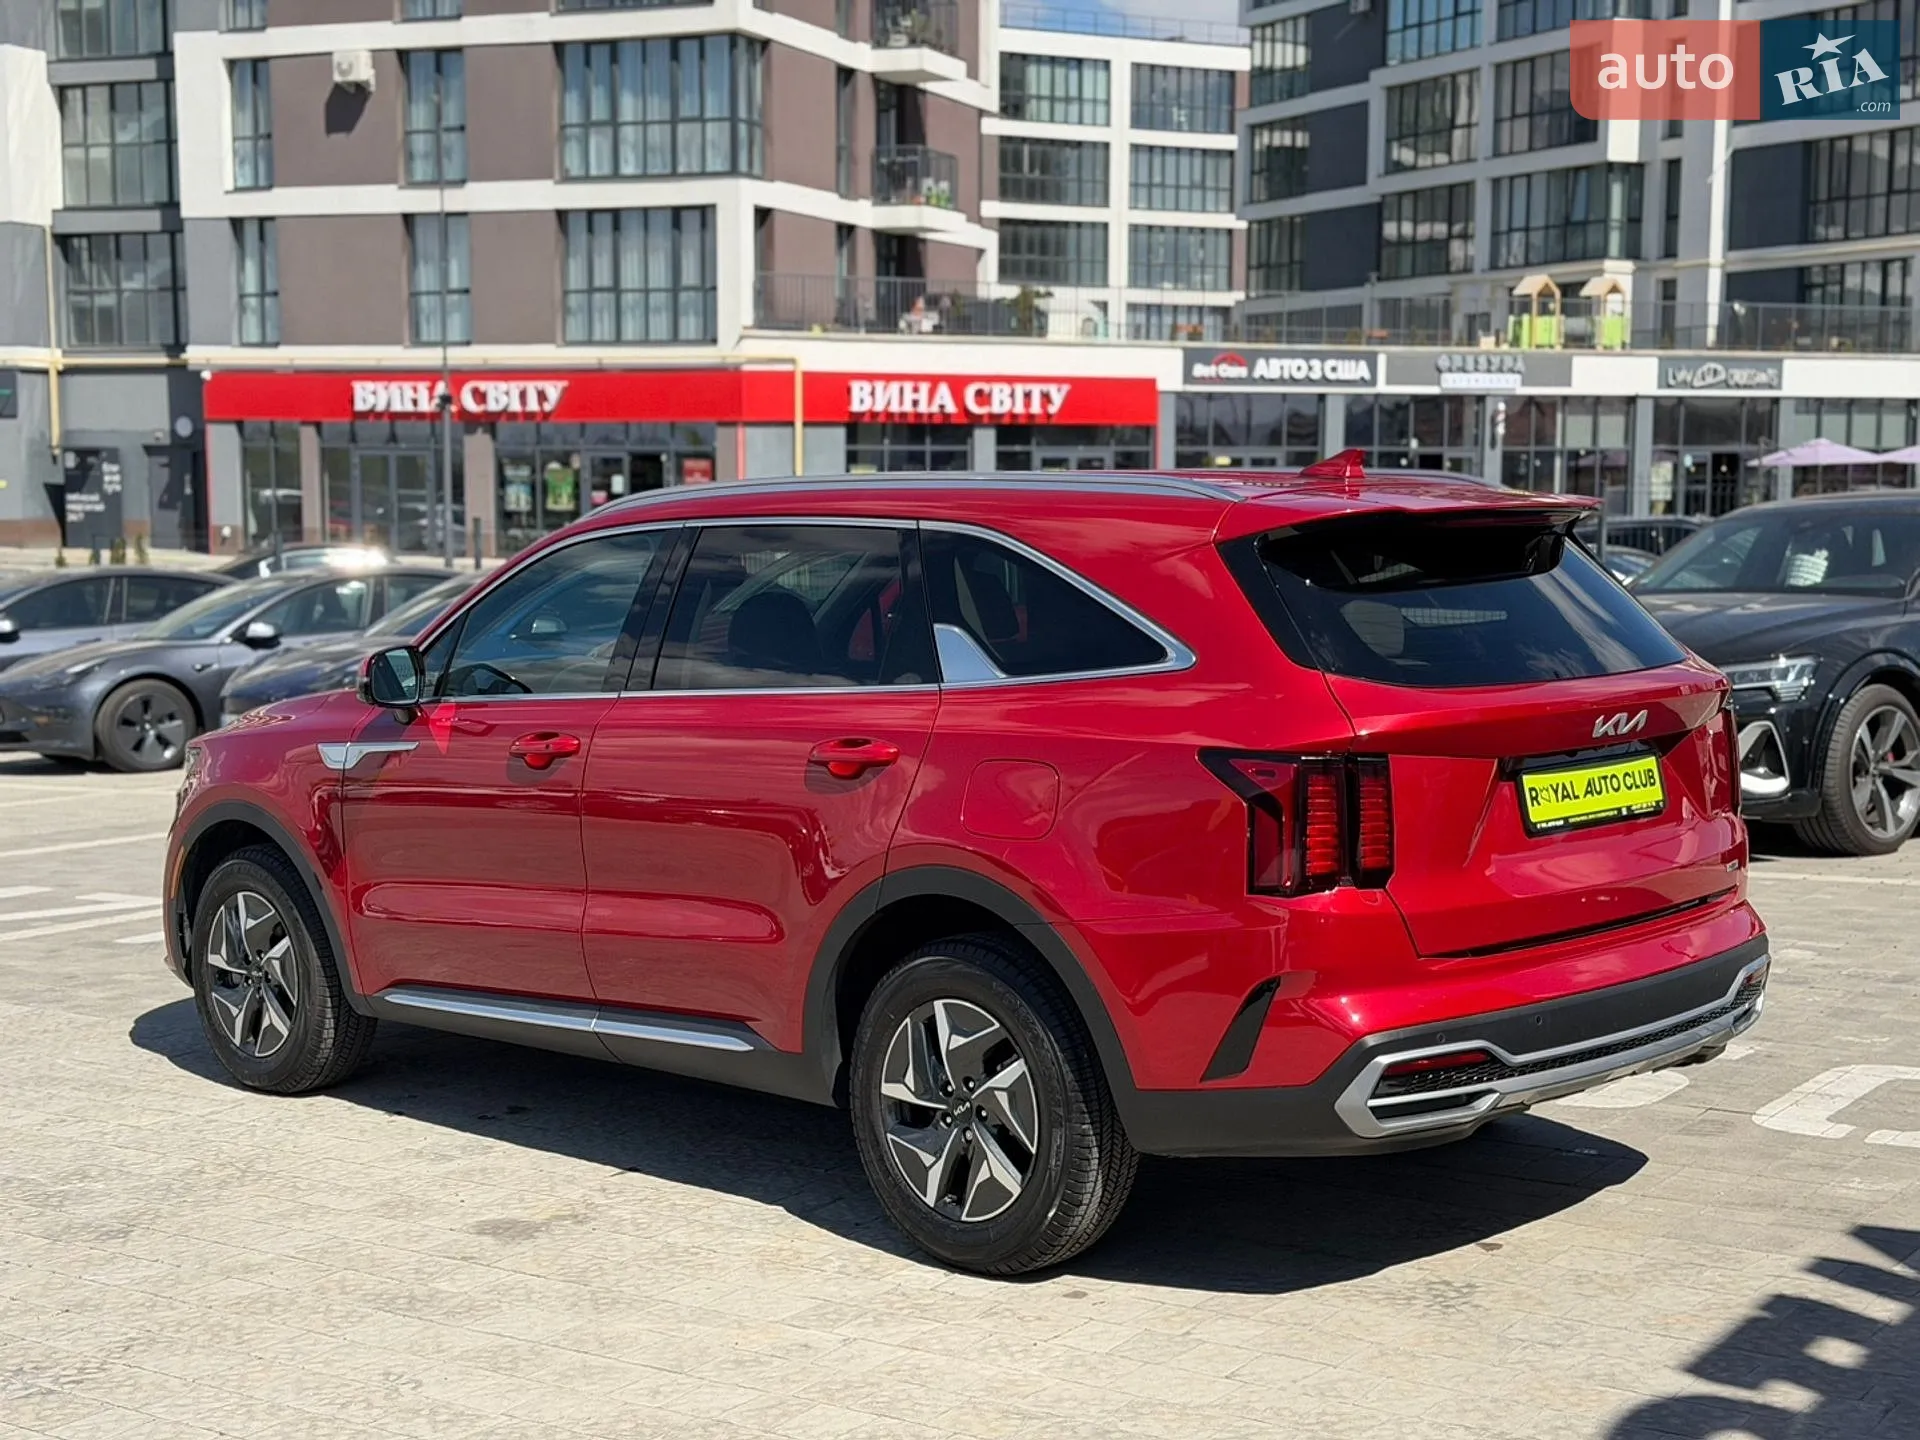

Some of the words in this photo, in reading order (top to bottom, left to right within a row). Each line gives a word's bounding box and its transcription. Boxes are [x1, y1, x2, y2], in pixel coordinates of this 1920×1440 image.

[1252, 358, 1307, 380] АВТО
[1323, 359, 1372, 382] США
[351, 380, 458, 413] ВИНА
[460, 380, 569, 414] СВІТУ
[849, 380, 959, 414] ВИНА
[963, 382, 1072, 416] СВІТУ
[1592, 709, 1648, 738] KIA
[1583, 773, 1622, 799] AUTO
[1622, 768, 1657, 792] CLUB
